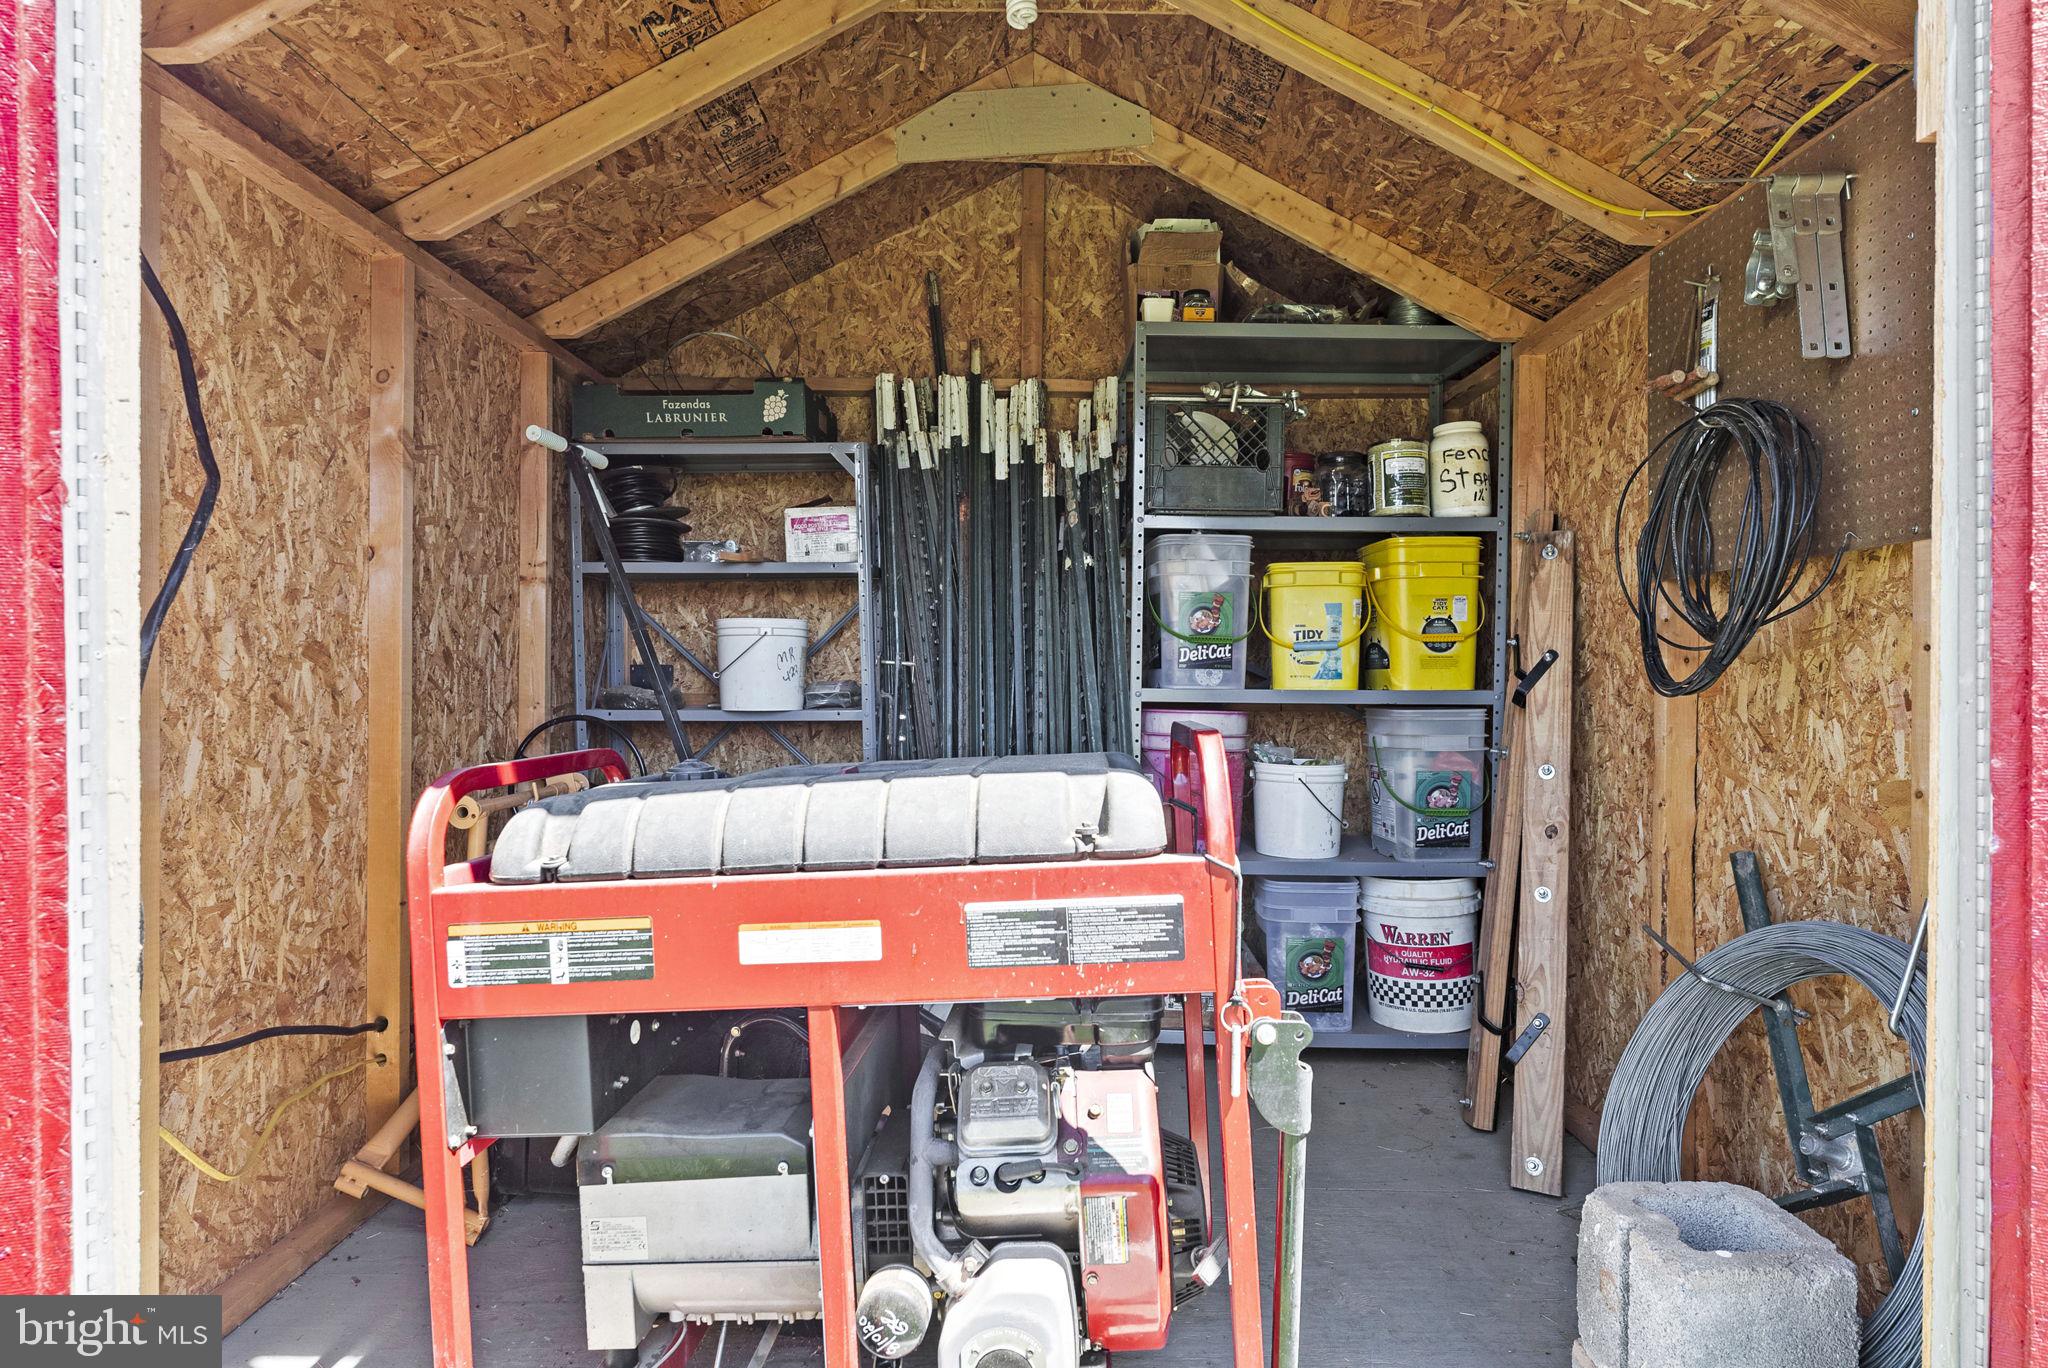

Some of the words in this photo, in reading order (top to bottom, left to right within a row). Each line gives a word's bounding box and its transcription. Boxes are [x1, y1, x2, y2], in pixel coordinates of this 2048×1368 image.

[662, 398, 711, 409] Fazendas
[646, 412, 727, 423] LABRUNIER
[1293, 630, 1324, 641] TIDY
[537, 922, 577, 932] WARNING
[1380, 923, 1451, 946] WARREN
[1401, 950, 1433, 958] QUALITY
[1384, 955, 1428, 966] HYDRAULIC
[1402, 968, 1435, 977] AW-32
[1385, 1003, 1404, 1011] CONTENTS
